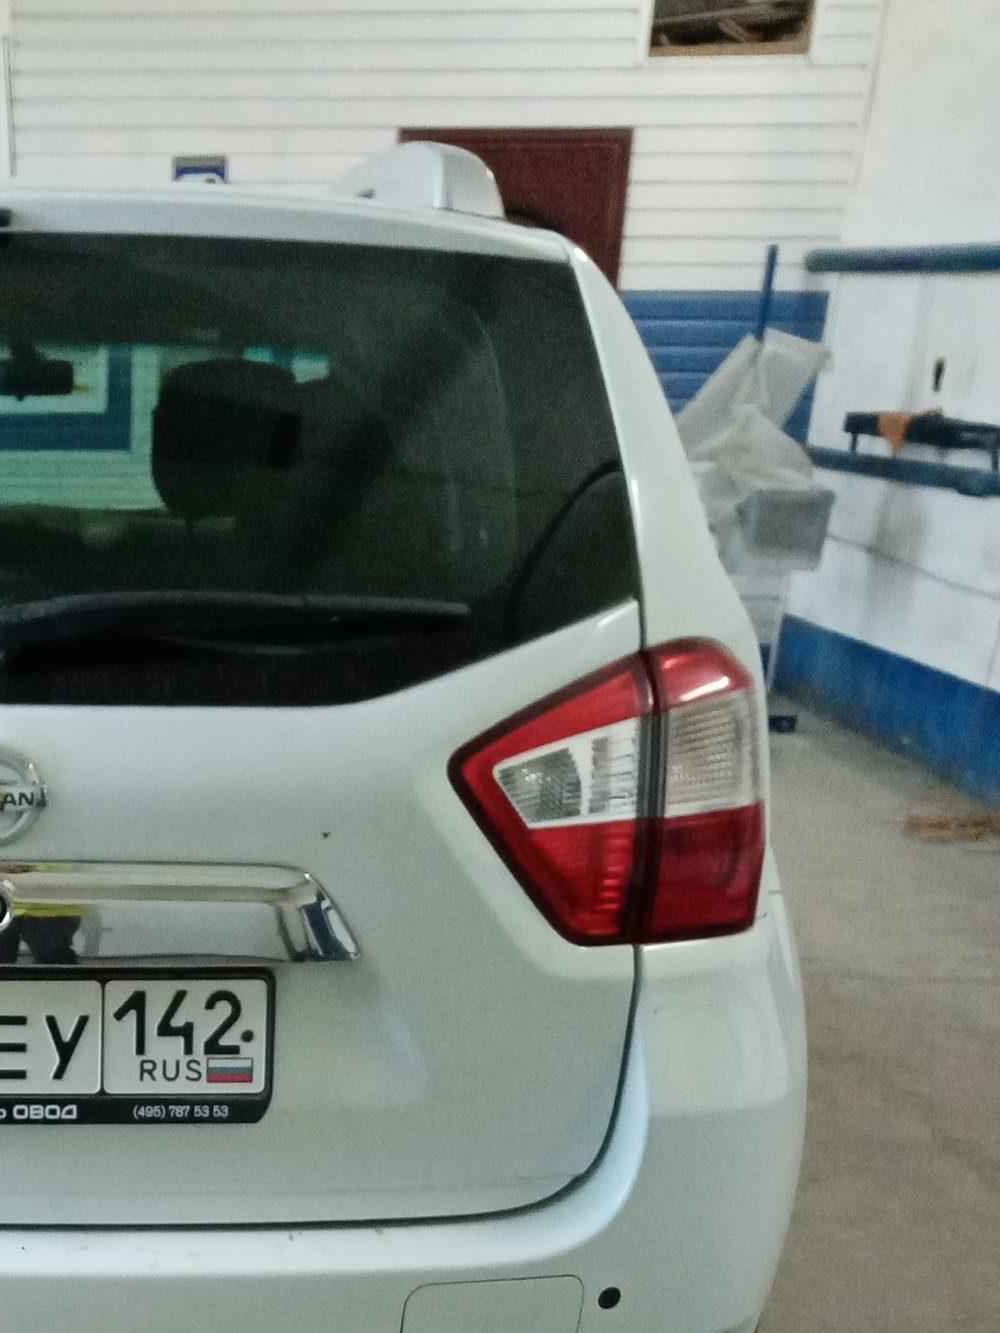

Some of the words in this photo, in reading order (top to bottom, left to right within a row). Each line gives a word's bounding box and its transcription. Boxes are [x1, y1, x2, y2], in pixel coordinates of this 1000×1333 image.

[113, 990, 242, 1056] 142
[139, 1059, 202, 1082] RUS
[132, 1104, 166, 1120] (495)
[168, 1105, 190, 1118] 787
[193, 1105, 210, 1118] 53
[212, 1105, 229, 1118] 53
